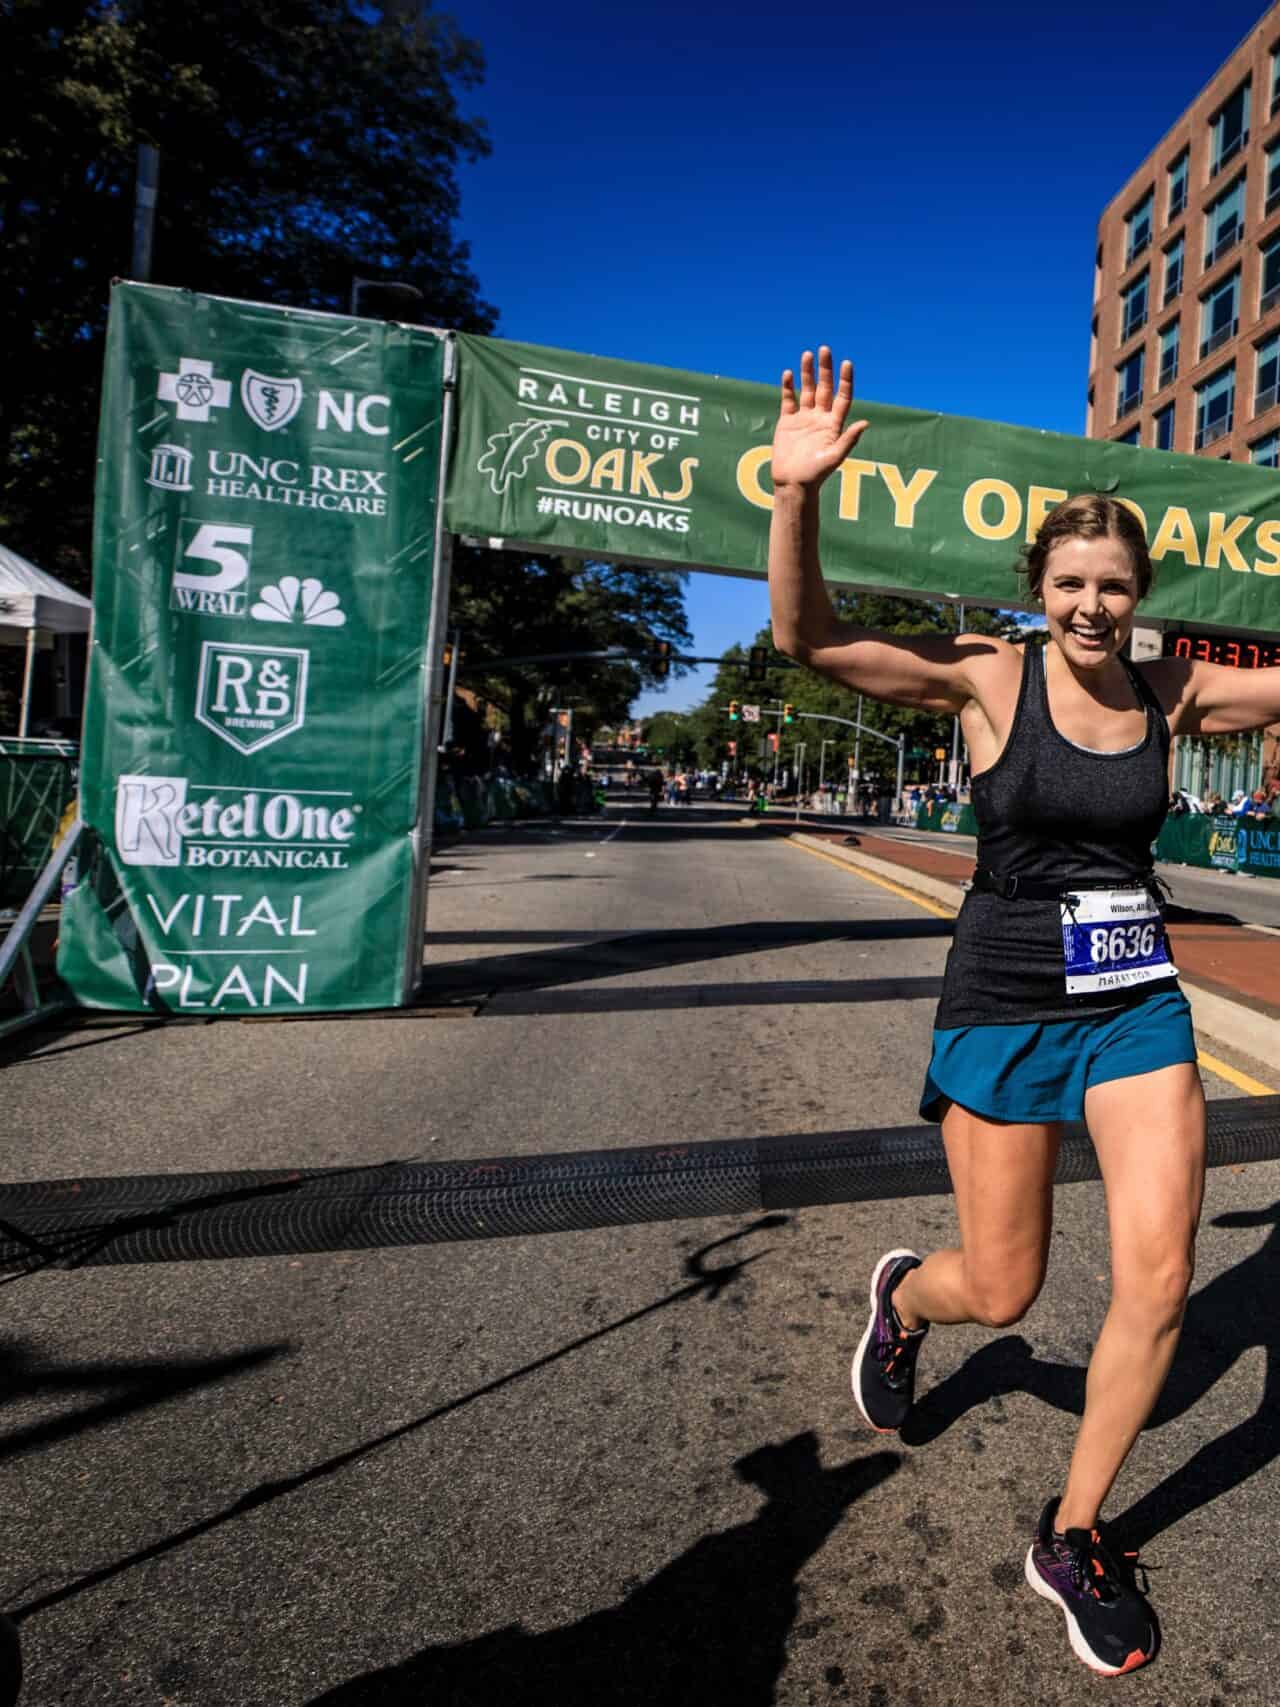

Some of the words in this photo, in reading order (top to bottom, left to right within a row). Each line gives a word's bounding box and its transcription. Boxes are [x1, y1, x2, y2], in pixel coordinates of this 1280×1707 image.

[317, 390, 391, 436] NC
[518, 377, 700, 426] RALEIGH
[587, 424, 639, 446] CITY
[650, 432, 680, 452] OF
[207, 450, 301, 485] UNC
[311, 466, 388, 496] REX
[545, 438, 699, 502] OAKS
[207, 480, 387, 516] HEALTHCARE
[537, 497, 690, 533] #RUNOAKS
[736, 445, 939, 529] CTY
[962, 478, 1068, 546] OF
[174, 525, 253, 594] 5
[175, 590, 246, 616] WRAL
[211, 655, 290, 716] R&D
[120, 783, 258, 860] Ketel
[263, 795, 355, 840] One
[185, 847, 349, 869] BOTANICAL
[147, 895, 318, 937] VITAL
[1089, 922, 1157, 963] 8636
[142, 963, 307, 1008] PLAN
